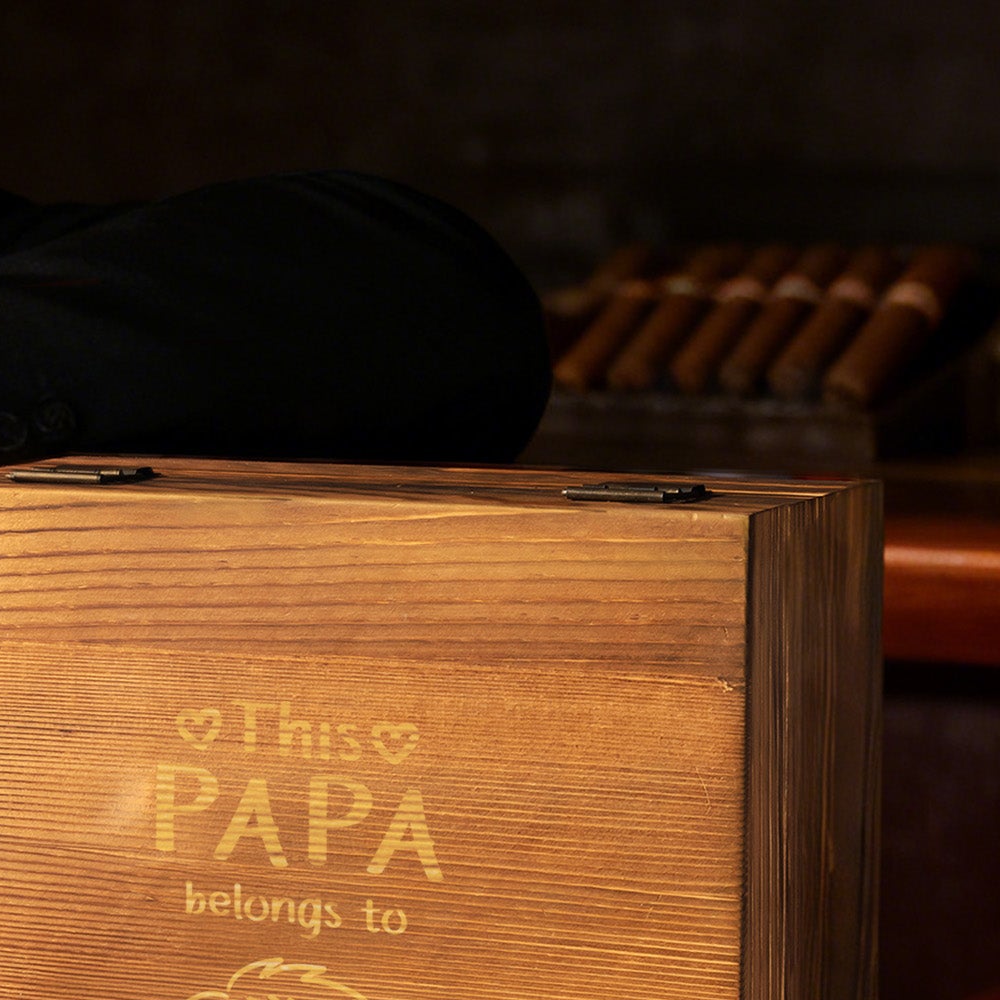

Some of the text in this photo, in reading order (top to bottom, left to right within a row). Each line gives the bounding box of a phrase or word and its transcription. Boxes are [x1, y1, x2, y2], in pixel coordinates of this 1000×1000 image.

[233, 700, 362, 762] This
[155, 763, 445, 882] PAPA
[185, 881, 408, 940] belongs to
